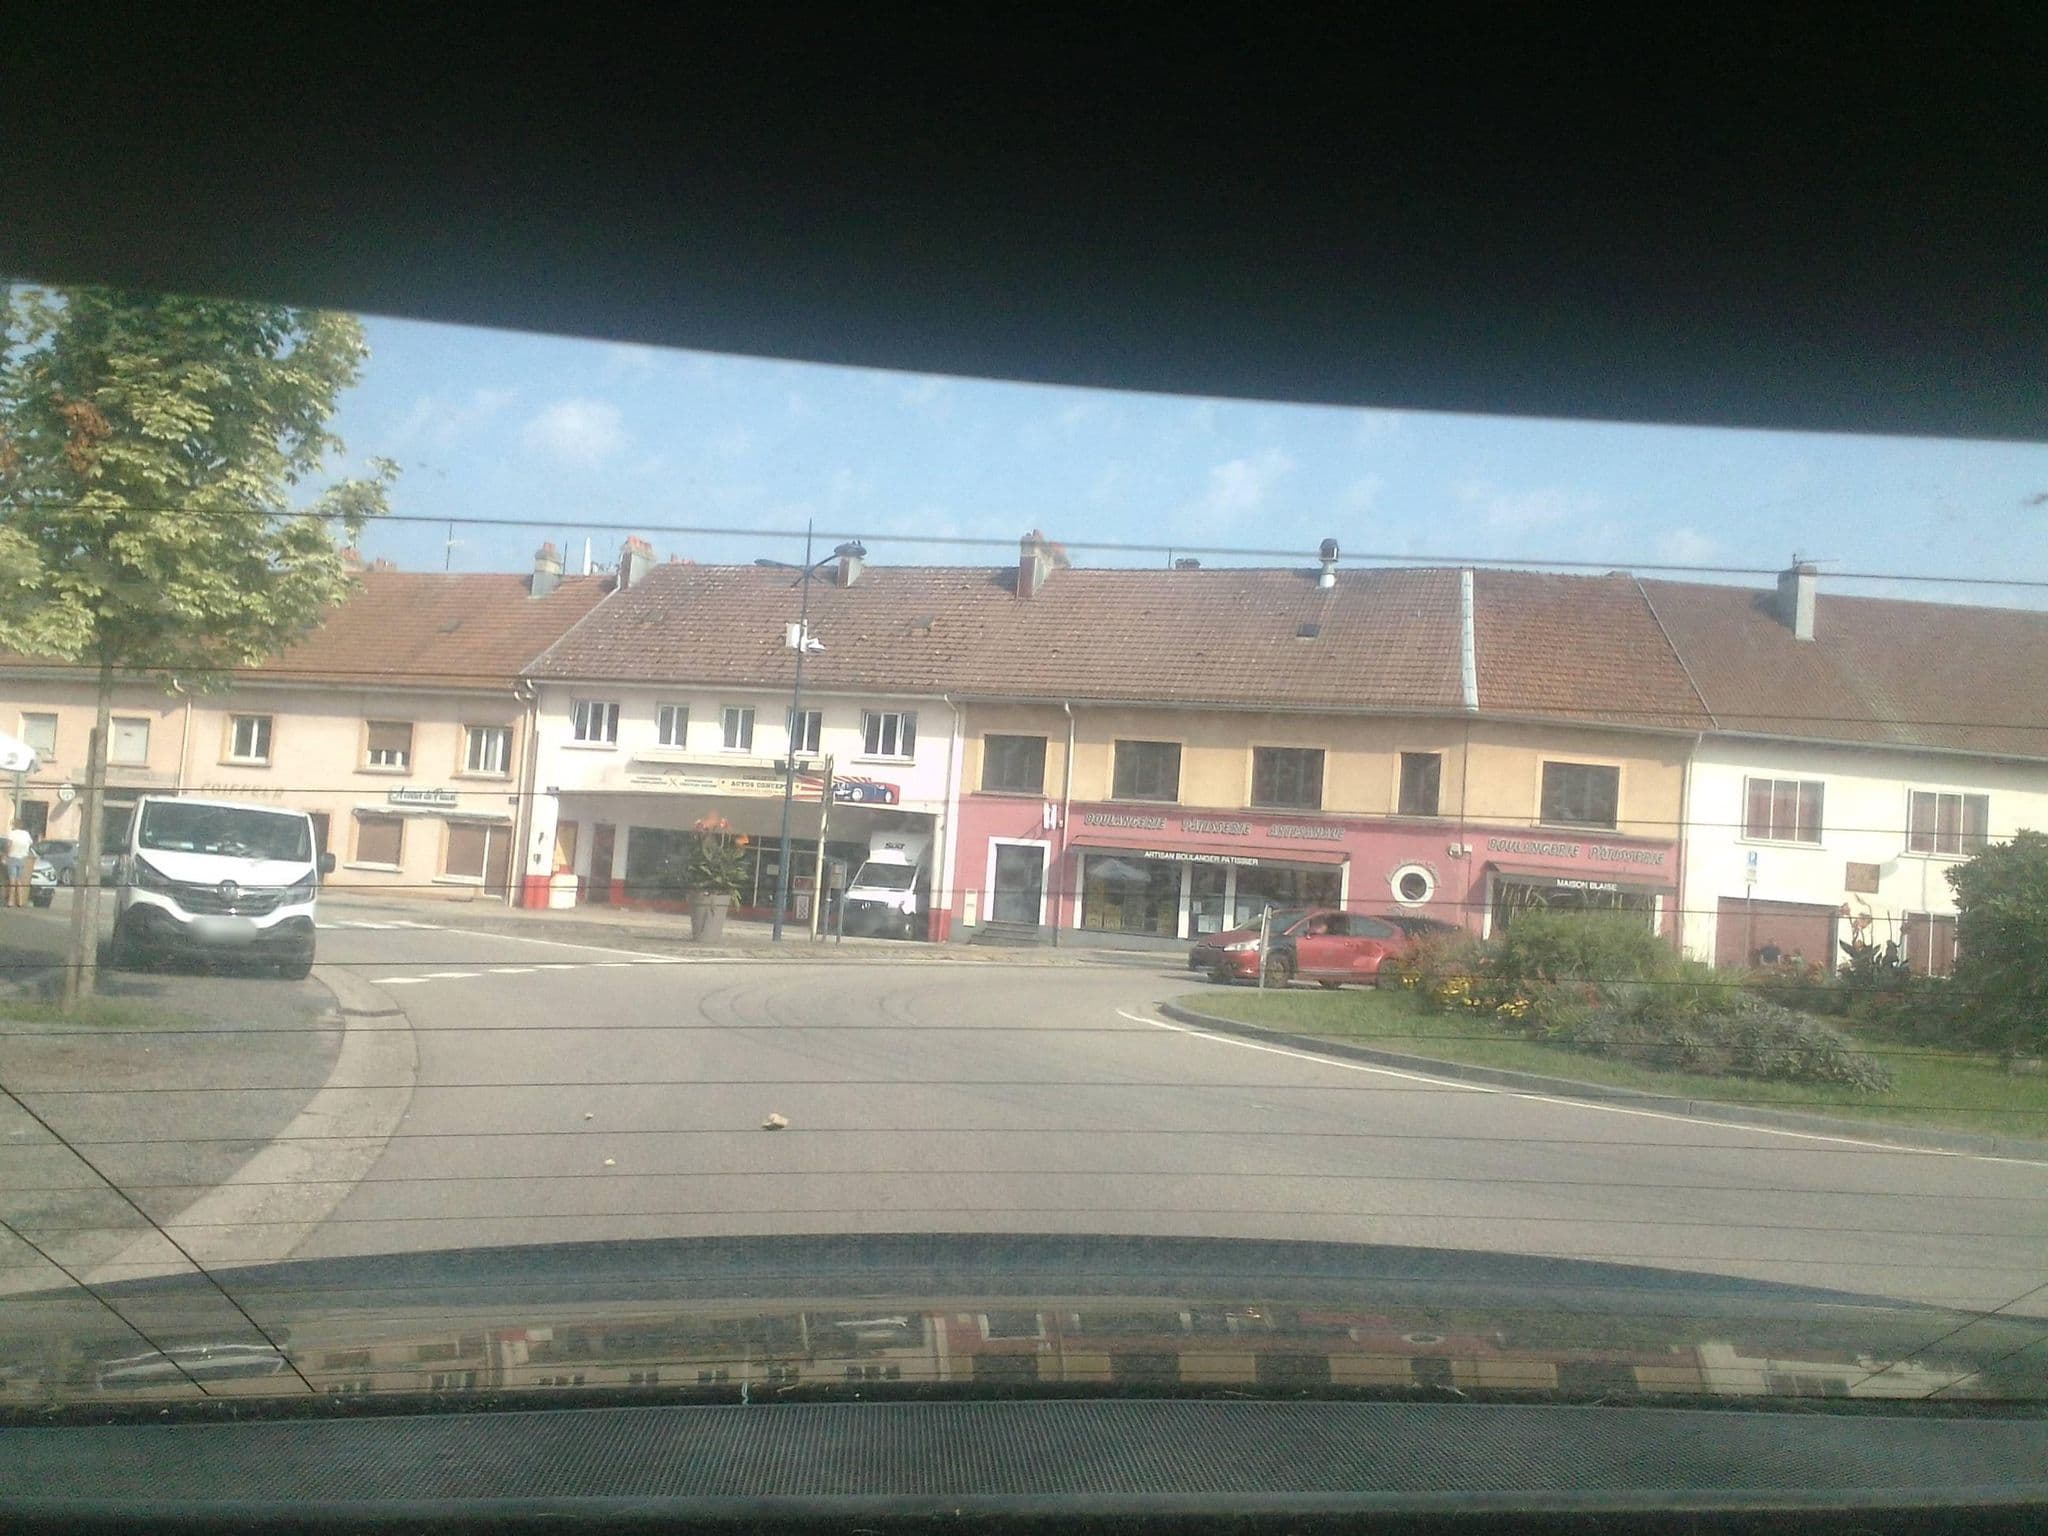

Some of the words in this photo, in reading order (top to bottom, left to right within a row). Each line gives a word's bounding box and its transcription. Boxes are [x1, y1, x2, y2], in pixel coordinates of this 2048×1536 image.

[1084, 812, 1168, 831] BOULANGERIE
[1488, 837, 1580, 859] BOULANGERIE
[1144, 850, 1175, 861] ARTISAN
[1176, 852, 1220, 863] BOULANGER
[1557, 879, 1588, 889] MAISON
[1590, 881, 1617, 891] BLAISE
